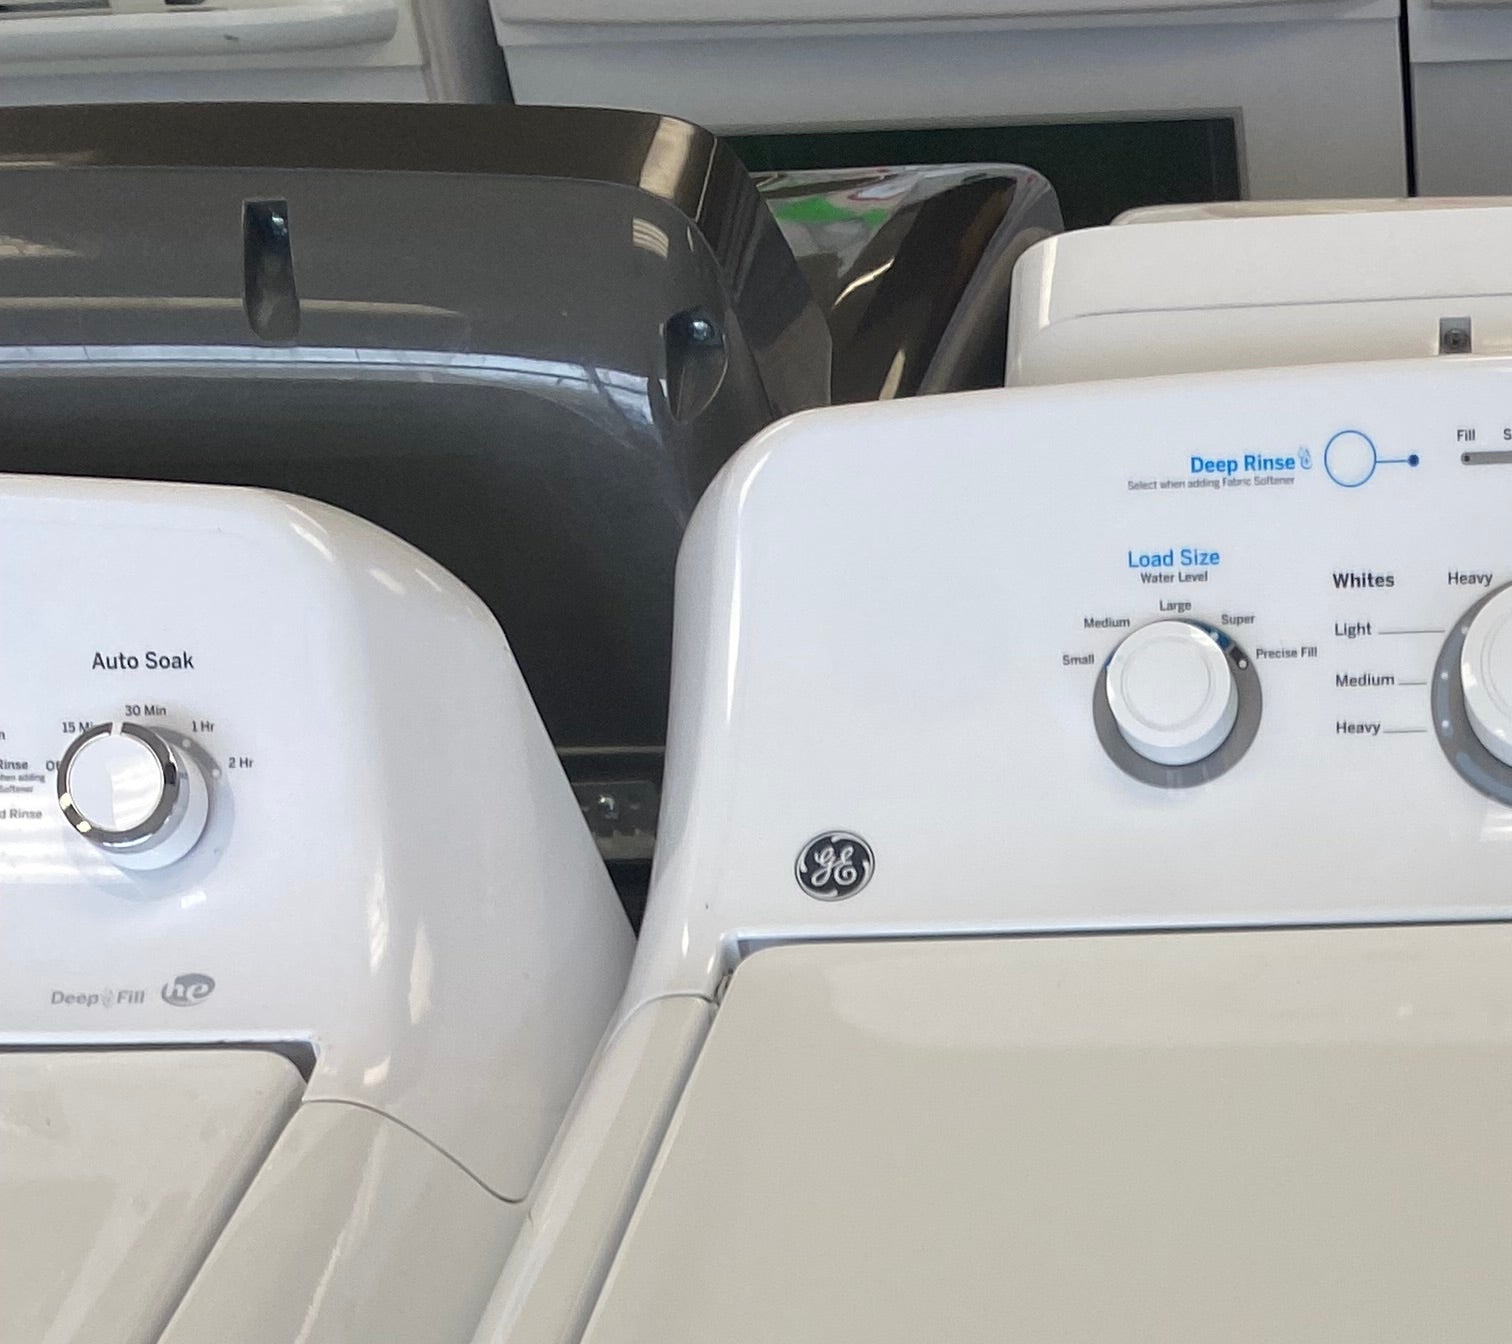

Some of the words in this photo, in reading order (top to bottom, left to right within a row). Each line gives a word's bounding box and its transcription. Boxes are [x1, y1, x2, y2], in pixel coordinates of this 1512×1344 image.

[1457, 429, 1476, 442] Fill
[1190, 455, 1238, 475] Deep
[1244, 454, 1296, 471] Rinse
[1127, 480, 1158, 491] Select
[1187, 477, 1220, 490] adding
[1222, 476, 1251, 488] Fabric
[1254, 475, 1295, 486] Softener
[1128, 550, 1174, 568] Load
[1180, 548, 1220, 566] Size
[1140, 571, 1175, 584] Water
[1178, 570, 1208, 583] Level
[1333, 573, 1395, 589] Whites
[1448, 571, 1494, 588] Heavy
[1159, 600, 1192, 613] Large
[1084, 617, 1131, 629] Medium
[1221, 613, 1256, 626] Super
[1335, 622, 1372, 638] Light
[1062, 654, 1095, 666] Small
[1256, 648, 1298, 660] Precise
[1301, 646, 1318, 659] Fill
[92, 651, 140, 671] Auto
[145, 651, 195, 671] Soak
[1336, 673, 1395, 688] Medium
[125, 704, 141, 717] 30
[144, 705, 167, 716] Min
[62, 721, 76, 733] 15
[192, 720, 198, 733] 1
[201, 719, 216, 733] Hr
[1336, 721, 1381, 736] Heavy
[228, 756, 238, 769] 2
[240, 756, 255, 769] Hr
[9, 808, 42, 819] Rinse
[51, 989, 99, 1008] Deep
[117, 990, 145, 1005] Fill
